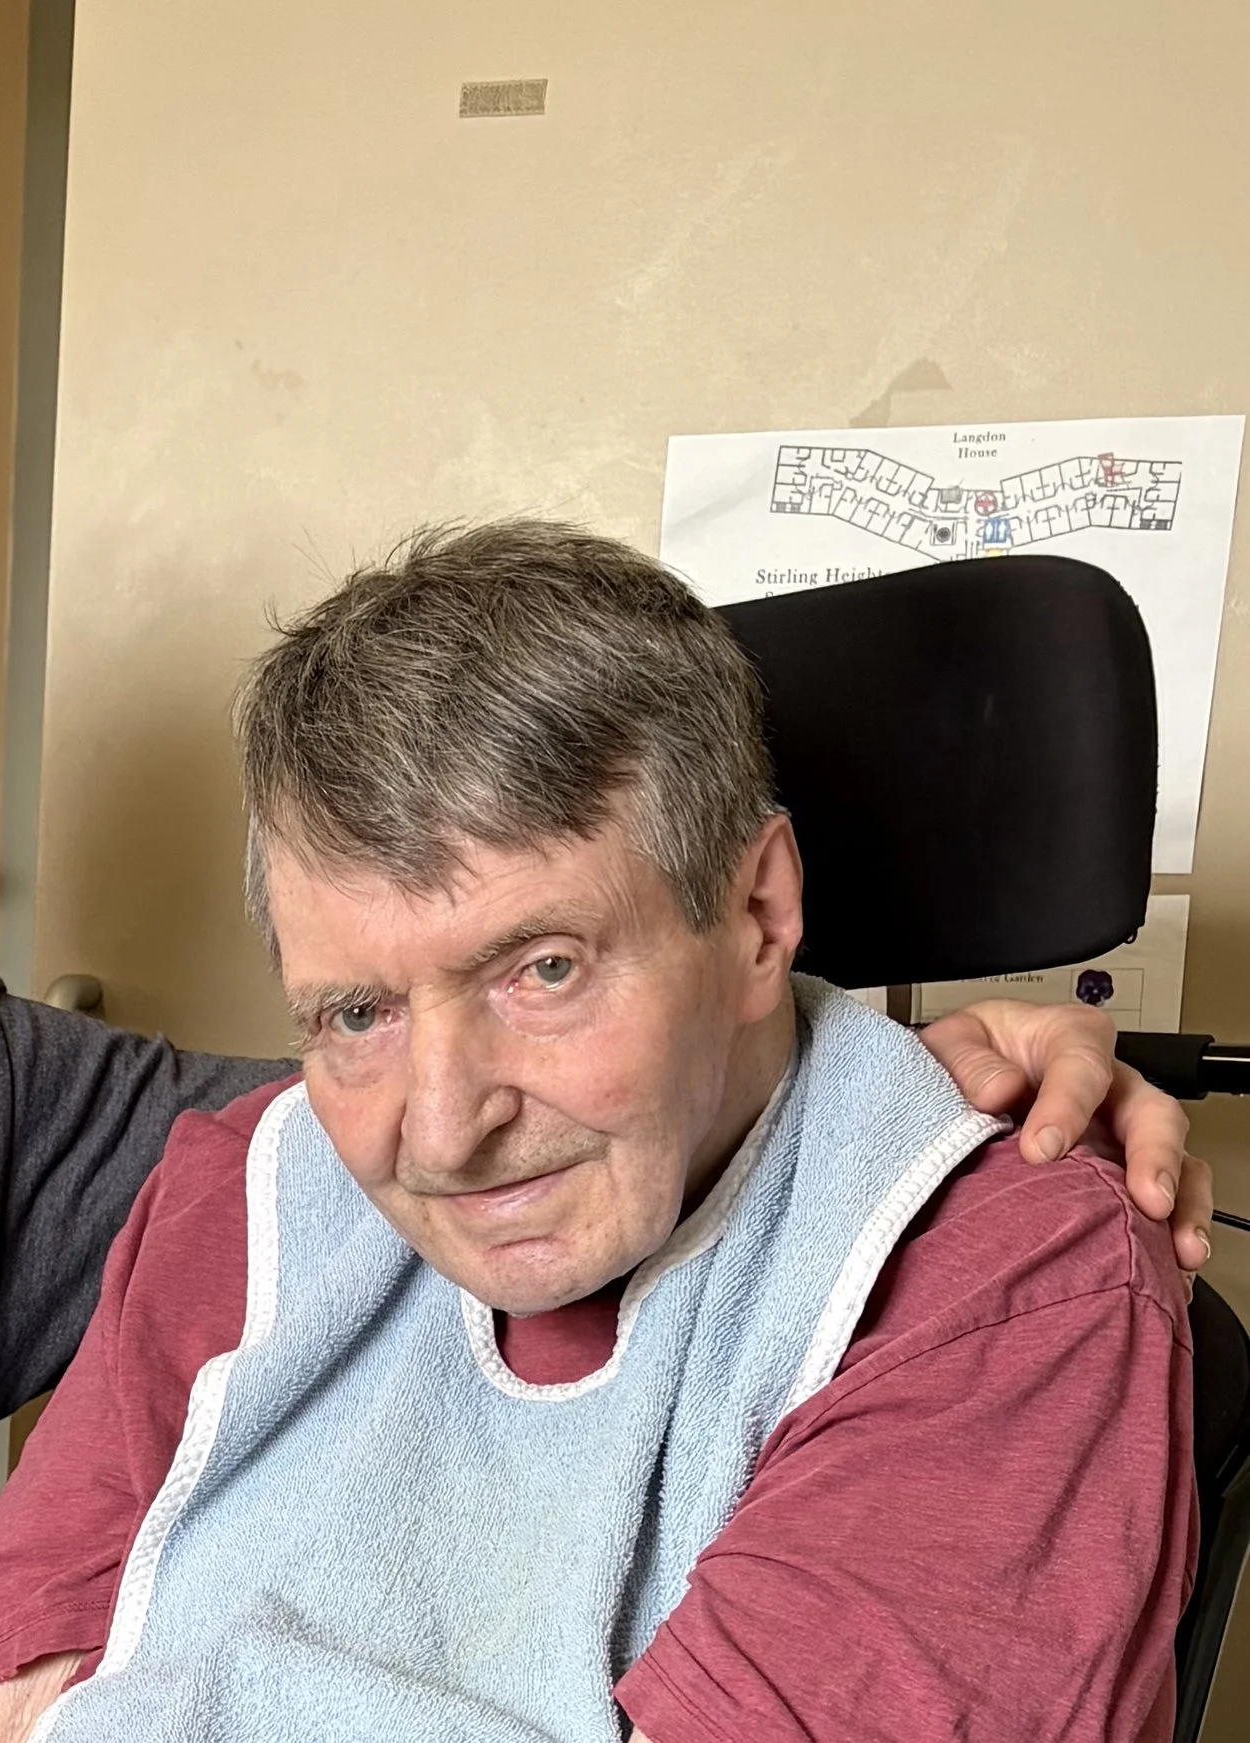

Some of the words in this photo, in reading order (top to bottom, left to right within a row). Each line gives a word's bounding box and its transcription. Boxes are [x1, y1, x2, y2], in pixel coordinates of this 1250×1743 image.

[953, 431, 1006, 444] Langdon
[958, 447, 998, 458] House
[755, 569, 818, 585] Stirling
